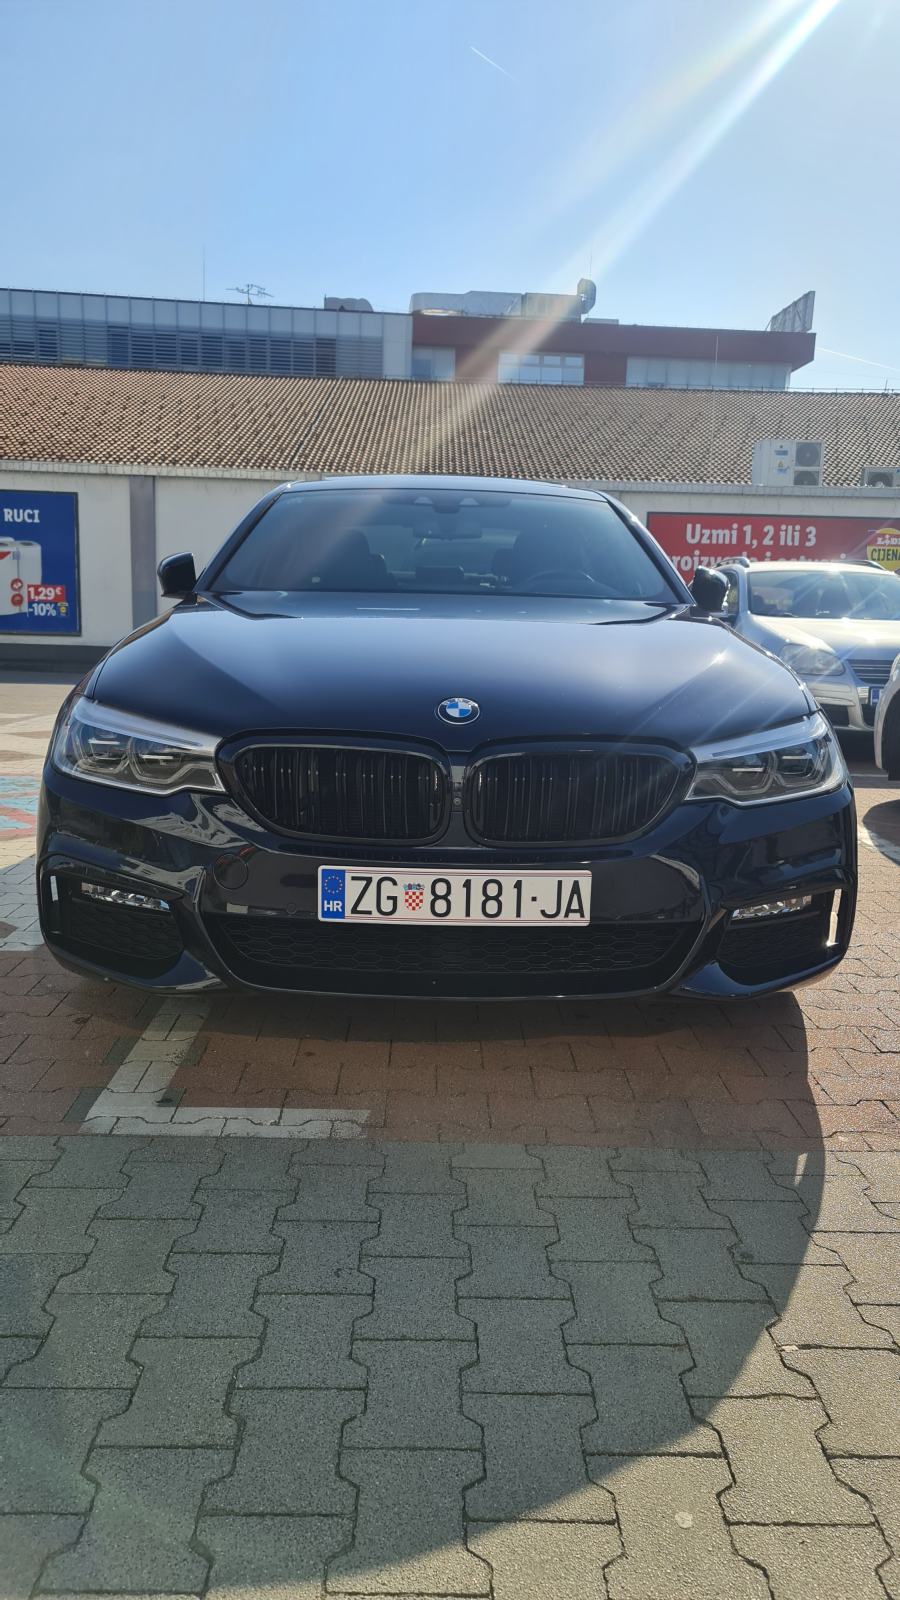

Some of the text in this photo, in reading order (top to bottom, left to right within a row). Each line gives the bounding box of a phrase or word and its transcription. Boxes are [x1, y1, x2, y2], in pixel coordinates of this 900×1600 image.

[3, 508, 40, 523] RUCI
[686, 523, 816, 549] Uzmi 1, 2 ili 3
[28, 586, 62, 601] 1,29€
[28, 603, 57, 617] -10%
[350, 876, 398, 916] ZG
[324, 900, 343, 912] HR
